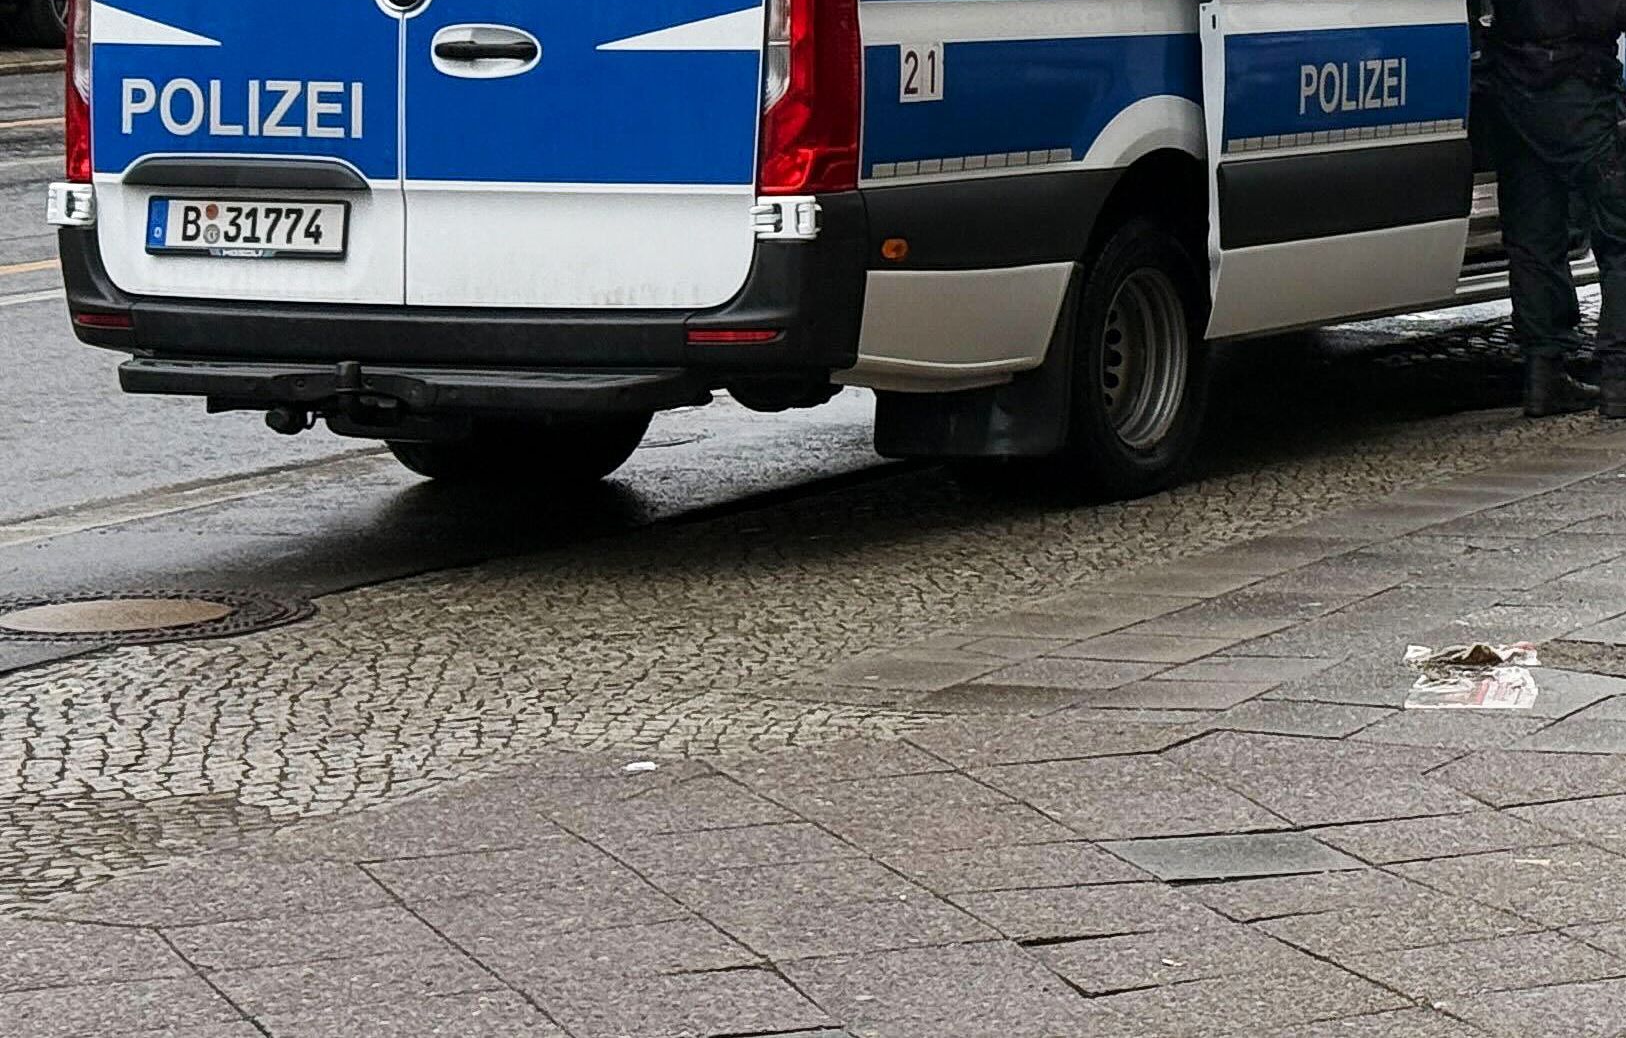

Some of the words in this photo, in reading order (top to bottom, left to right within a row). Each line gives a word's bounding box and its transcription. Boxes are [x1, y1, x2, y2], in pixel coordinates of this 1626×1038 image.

[904, 49, 936, 95] 21
[1299, 57, 1406, 115] POLIZEI
[121, 77, 363, 139] POLIZEI
